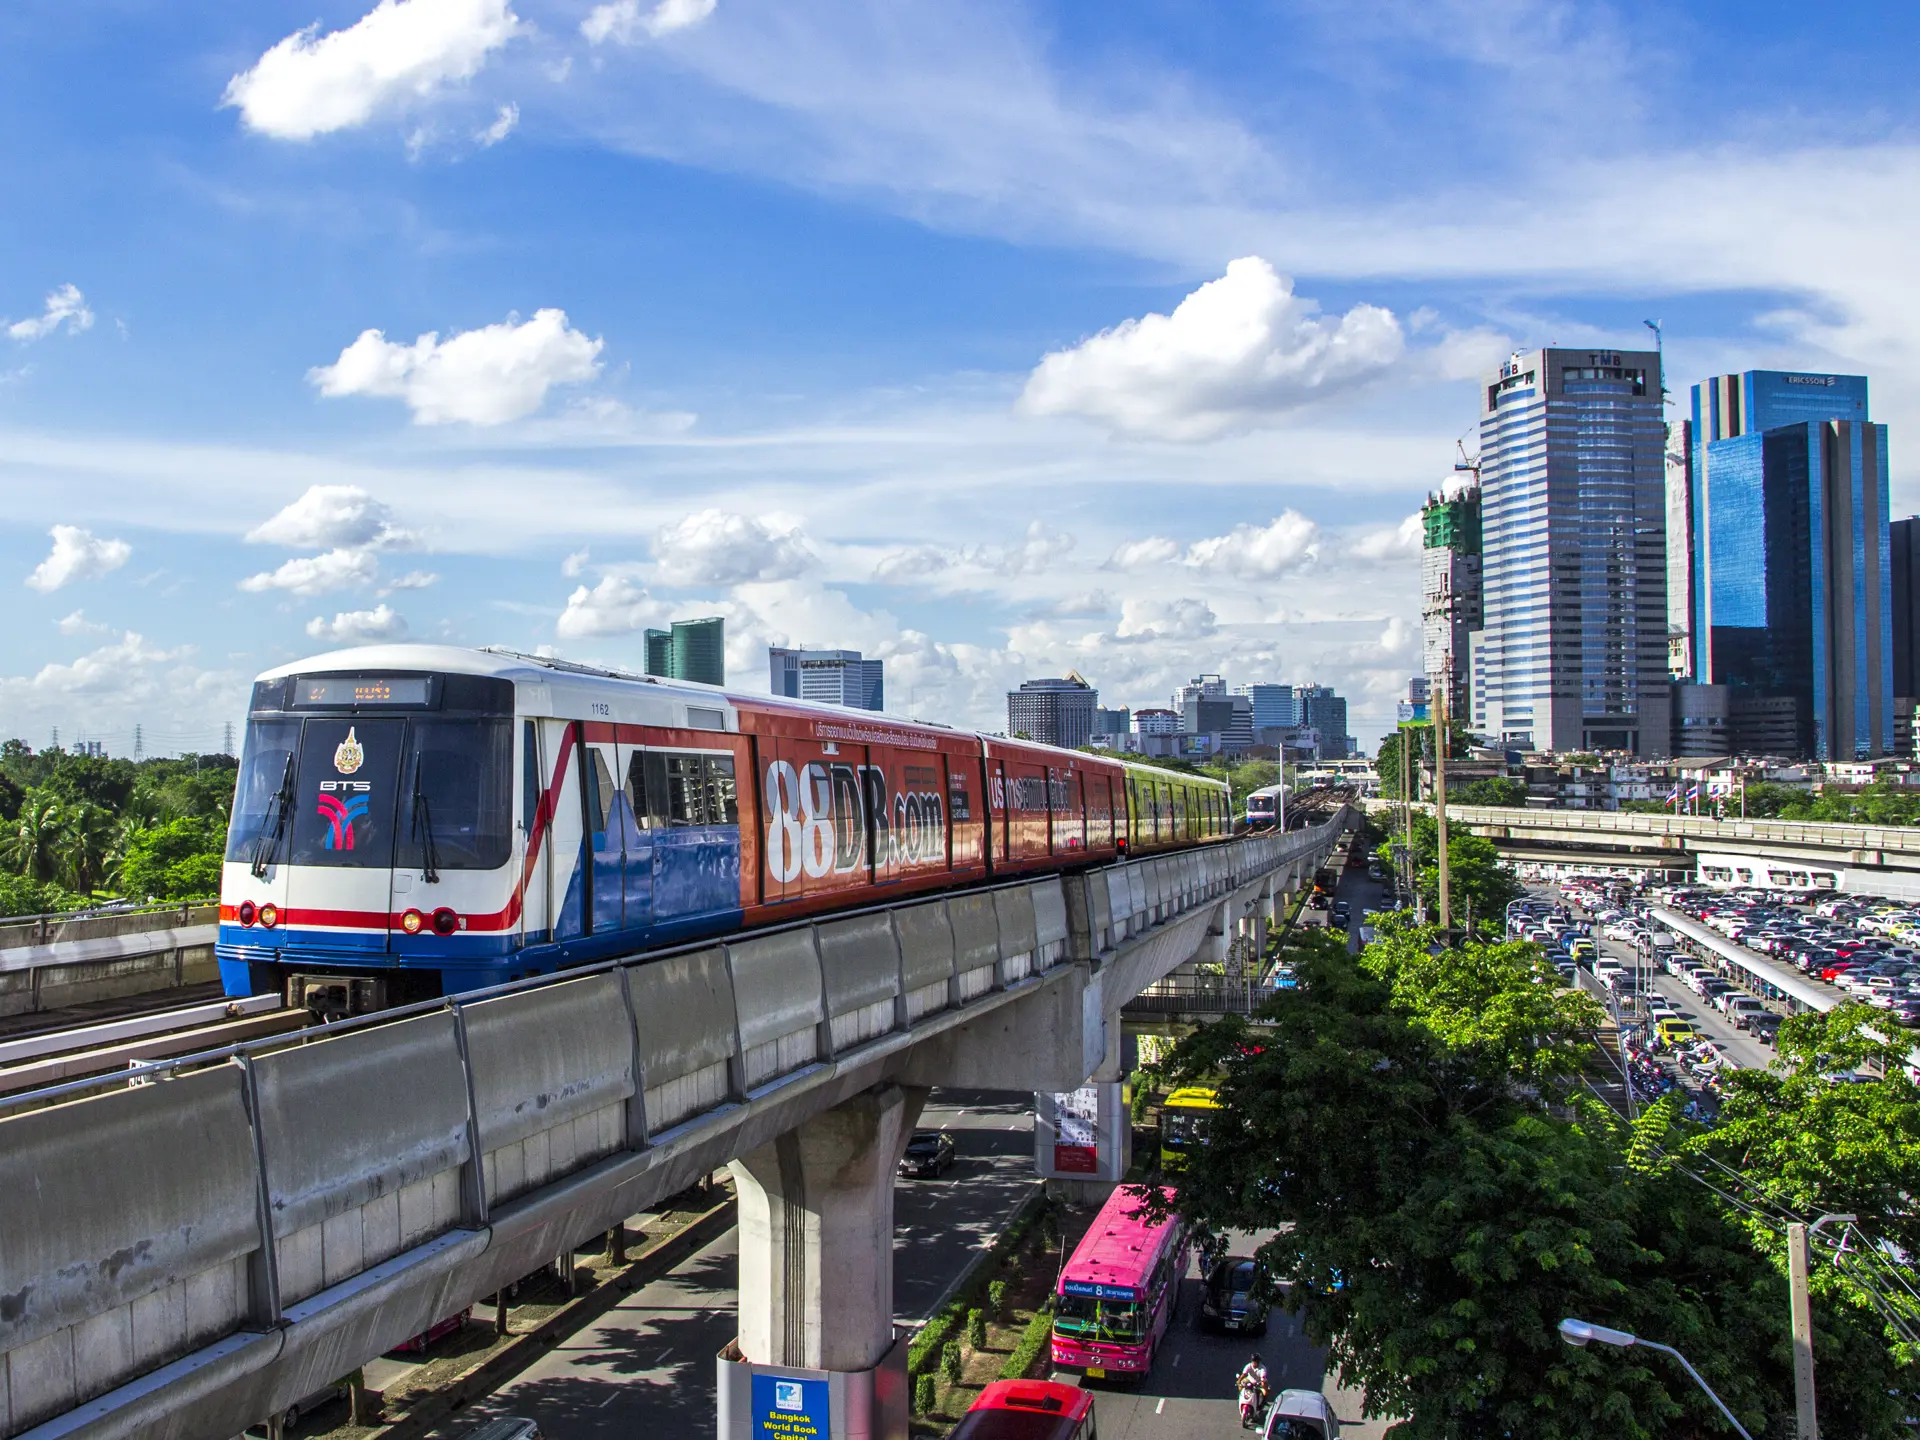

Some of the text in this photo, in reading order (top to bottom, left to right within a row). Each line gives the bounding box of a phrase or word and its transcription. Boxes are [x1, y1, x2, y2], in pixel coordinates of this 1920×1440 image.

[1589, 350, 1621, 366] TMB
[1500, 361, 1519, 380] TMB
[1788, 376, 1825, 385] ERICSSON
[592, 703, 609, 716] 1162
[320, 781, 371, 791] BTS
[766, 760, 944, 883] 88DB.com
[1096, 1285, 1103, 1296] 8
[769, 1411, 811, 1423] Bangkok
[763, 1421, 817, 1434] World Book
[774, 1432, 808, 1440] Capital
